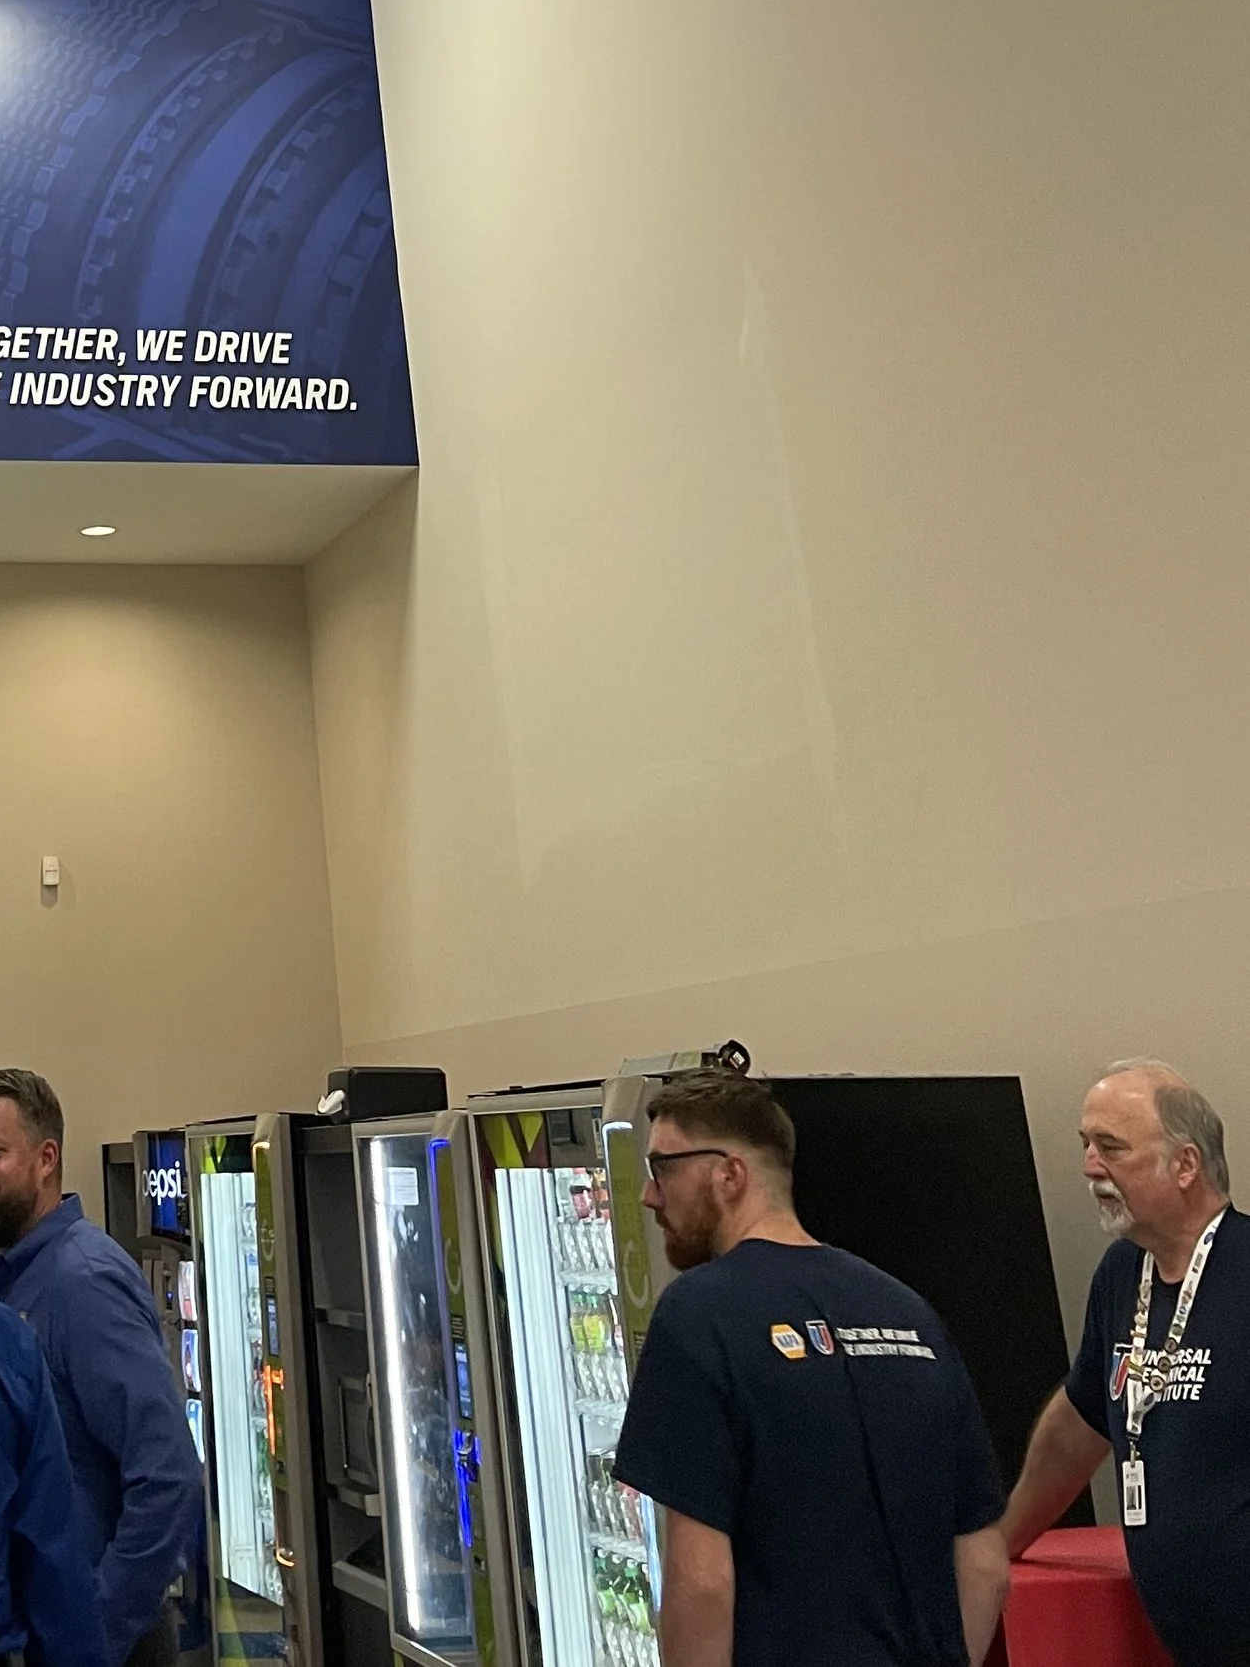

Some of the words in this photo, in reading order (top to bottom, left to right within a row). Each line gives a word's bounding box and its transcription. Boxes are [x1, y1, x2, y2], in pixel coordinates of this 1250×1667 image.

[136, 329, 187, 362] WE
[194, 330, 293, 364] DRIVE
[9, 372, 182, 408] INDUSTRY
[189, 375, 358, 411] FORWARD.
